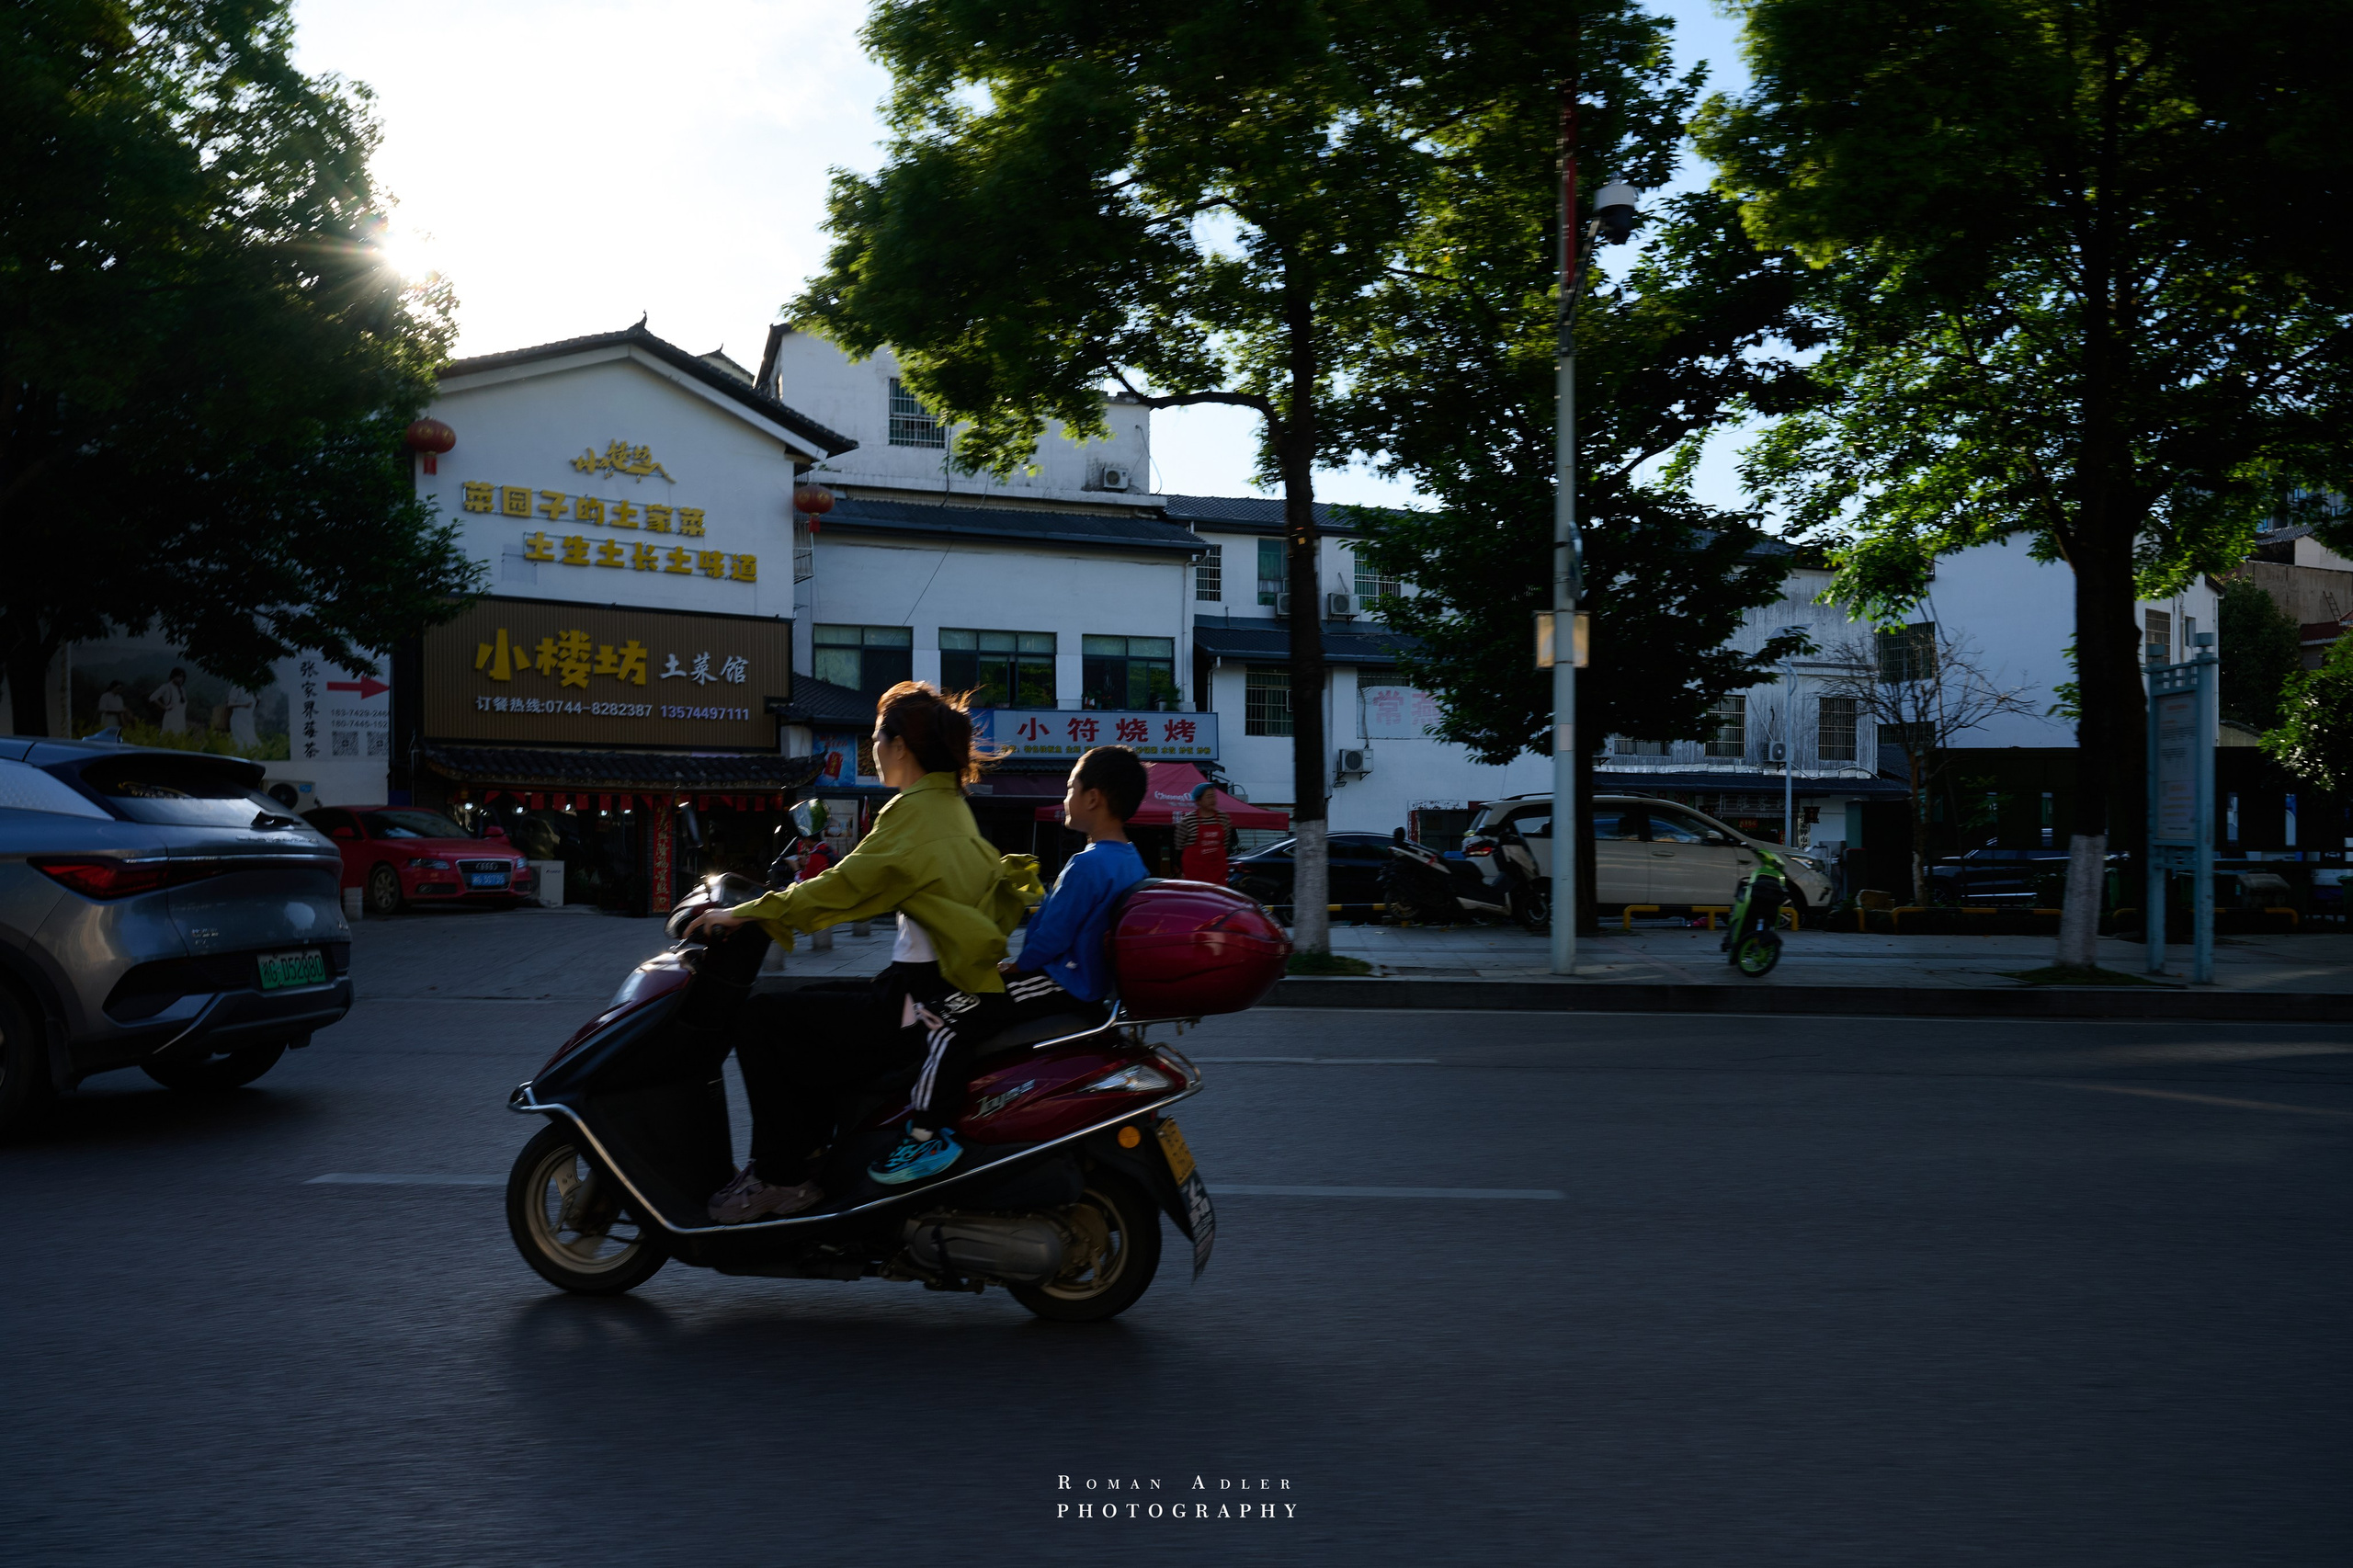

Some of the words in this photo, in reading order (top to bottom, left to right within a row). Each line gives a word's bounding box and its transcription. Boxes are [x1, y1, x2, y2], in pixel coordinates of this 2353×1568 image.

[463, 480, 706, 537] 菜园子的土家菜
[525, 531, 756, 582] 土生土长土味道
[474, 628, 647, 689] 小楼坊
[659, 651, 749, 686] 土菜馆
[660, 704, 750, 721] 13574497111
[1017, 717, 1197, 744] 小符烧烤
